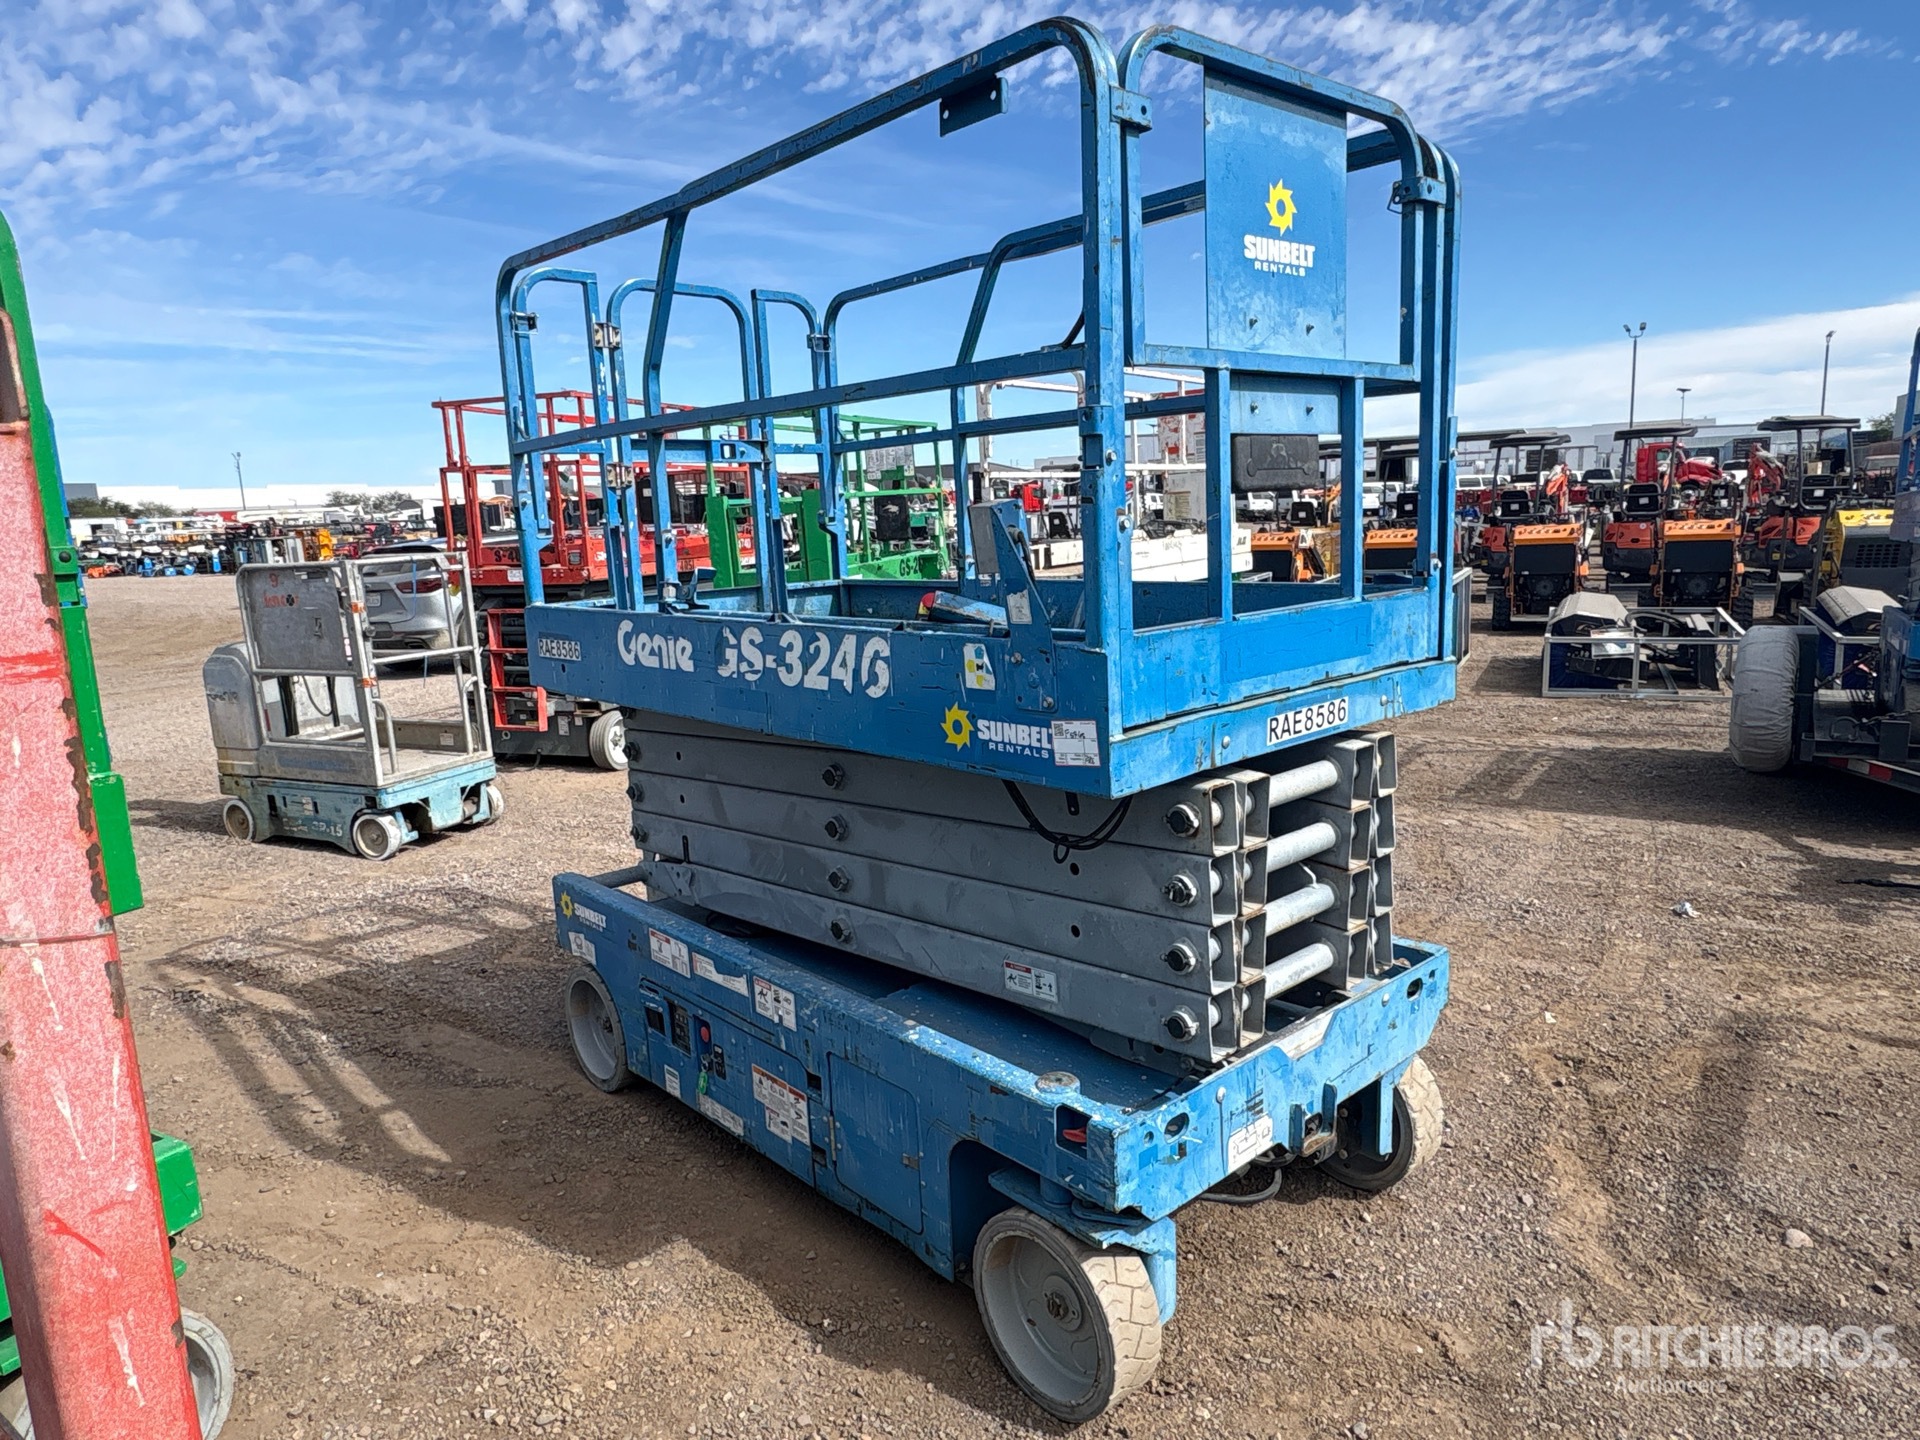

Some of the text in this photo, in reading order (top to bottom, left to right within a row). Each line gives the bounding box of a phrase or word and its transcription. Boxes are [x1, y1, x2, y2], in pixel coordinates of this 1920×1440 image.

[1243, 234, 1316, 268] SUNBELT
[1254, 260, 1306, 277] RENTALS
[539, 638, 581, 660] RAE8586
[617, 619, 890, 698] Genie GS-3246
[1268, 698, 1347, 743] RAE8586
[988, 741, 1050, 759] RENTALS
[574, 902, 607, 928] SUNBELT
